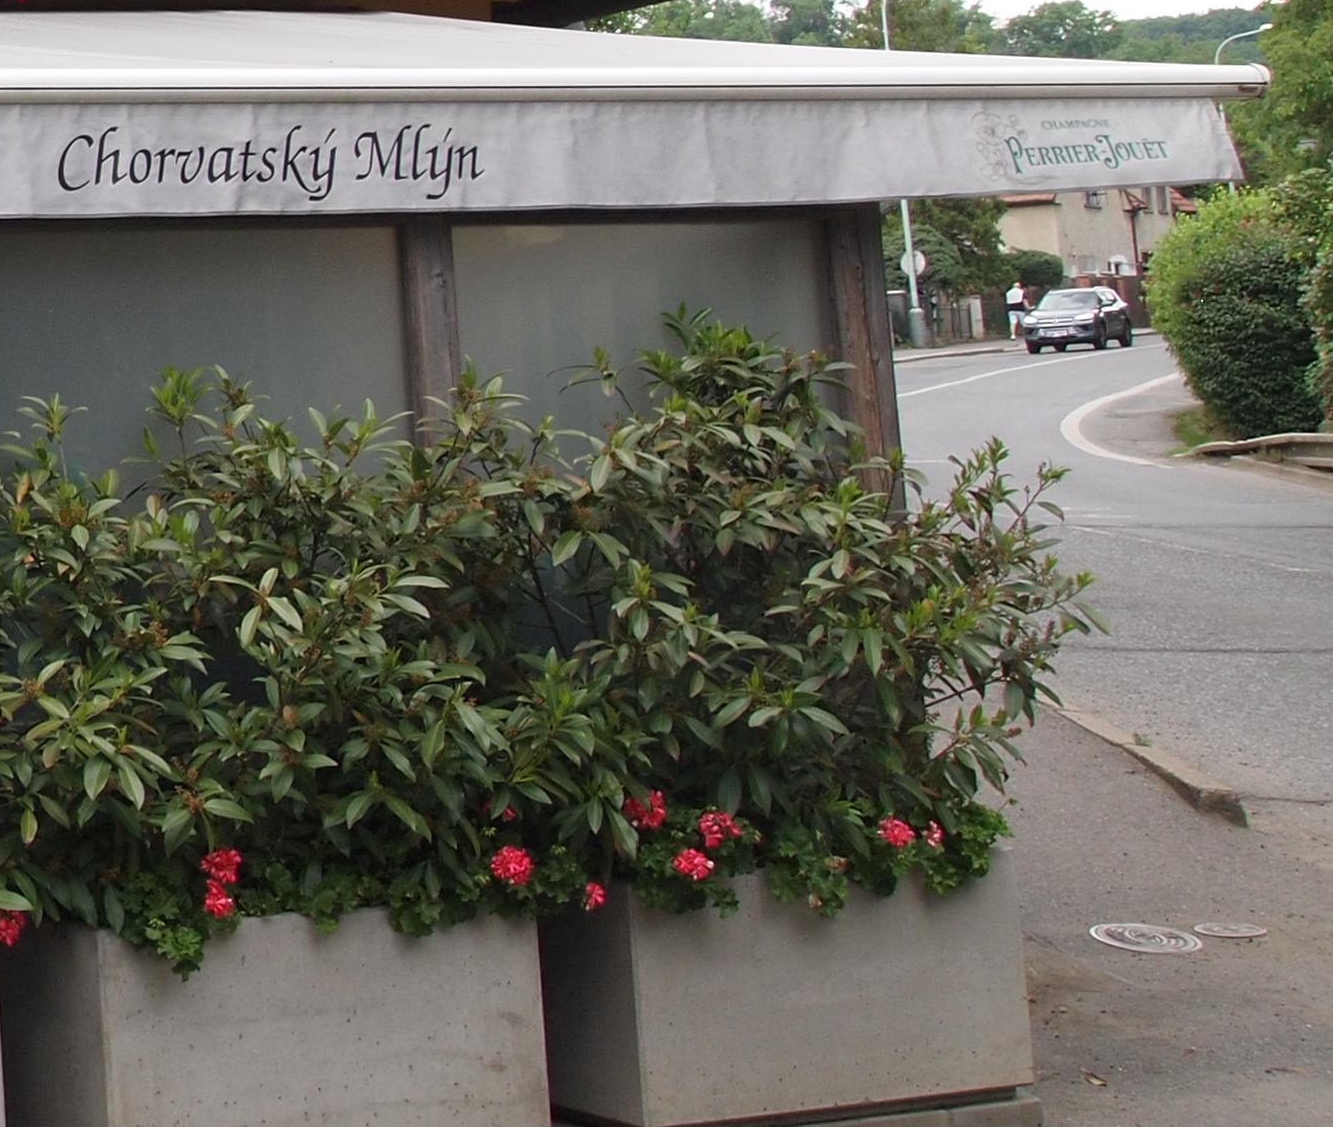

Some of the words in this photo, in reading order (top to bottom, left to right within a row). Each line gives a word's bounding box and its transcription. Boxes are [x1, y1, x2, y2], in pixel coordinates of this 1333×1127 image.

[1040, 118, 1112, 131] CHAMPAGNE
[57, 124, 337, 202] Chorvatský
[353, 123, 486, 201] Mlýn
